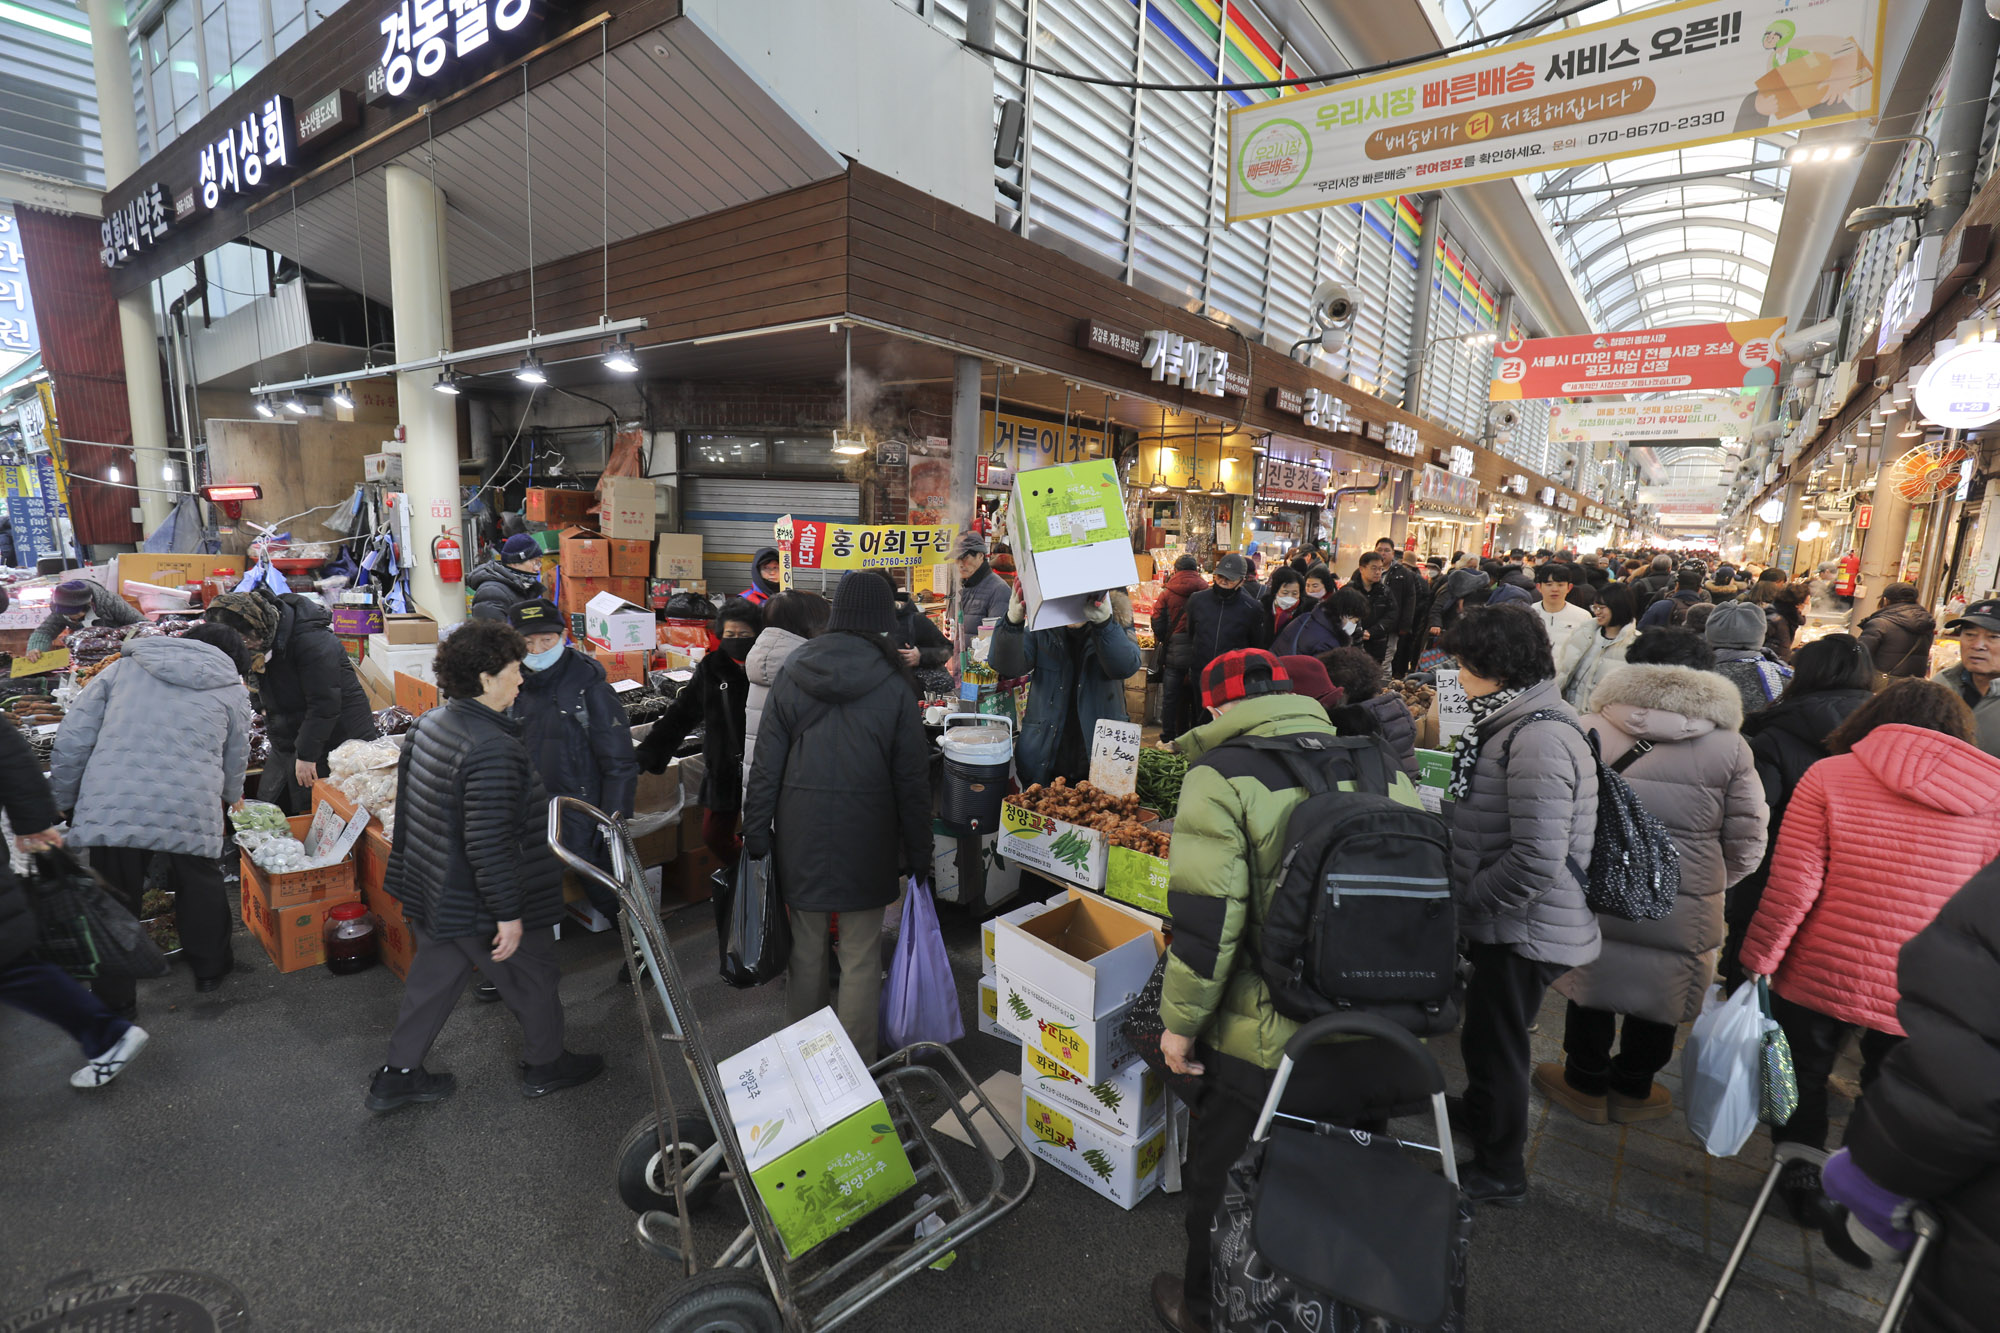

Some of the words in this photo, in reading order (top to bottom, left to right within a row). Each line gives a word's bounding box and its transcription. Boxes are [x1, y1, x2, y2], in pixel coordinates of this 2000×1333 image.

[1316, 86, 1416, 131] 우리시장
[1422, 61, 1535, 109] 빠른배송
[1544, 38, 1640, 83] 서비스
[1649, 11, 1742, 61] 오픈!!
[1468, 115, 1490, 135] 더
[200, 94, 287, 209] 성지상회
[1256, 137, 1302, 160] 우리시장
[1415, 155, 1475, 177] 참여점포를
[1478, 144, 1545, 165] 확인하세요.
[1587, 110, 1725, 146] 070-8670-2330
[1531, 354, 1569, 367] 서울시
[1571, 351, 1612, 366] 디자인
[1614, 349, 1642, 362] 혁신
[1644, 344, 1702, 361] 전통시장
[1704, 341, 1735, 356] 조성
[1745, 342, 1769, 362] 축
[1501, 361, 1522, 380] 경
[1585, 361, 1638, 377] 공모사업
[1640, 359, 1670, 373] 선정
[996, 421, 1059, 463] 거북이
[886, 453, 899, 463] 25
[1269, 465, 1323, 492] 진광젓갈
[799, 523, 817, 566] 소문난
[831, 528, 953, 558] 홍어회무침
[862, 556, 922, 567] 010-2760-3360
[1005, 802, 1057, 837] 청양고추
[1149, 873, 1168, 888] 청양
[739, 1068, 761, 1100] 청양고추
[838, 1160, 888, 1197] 청양고추
